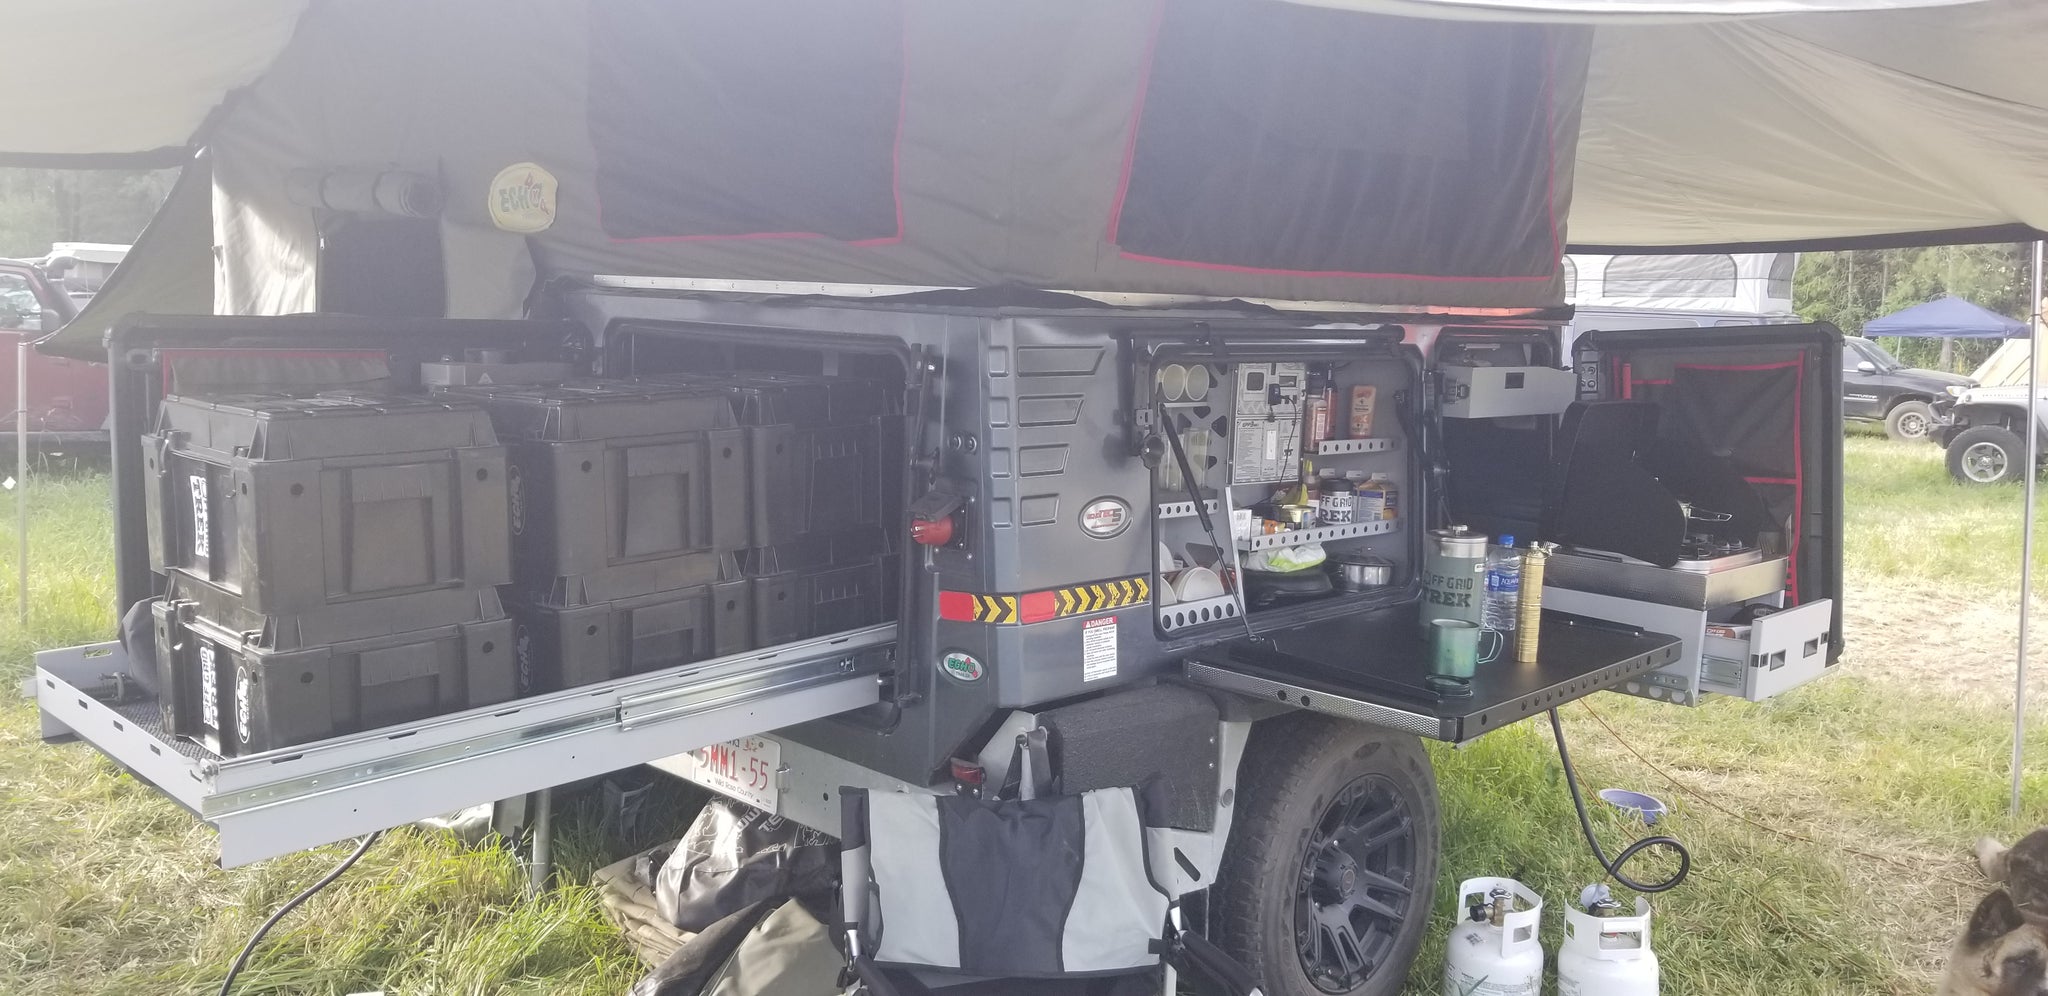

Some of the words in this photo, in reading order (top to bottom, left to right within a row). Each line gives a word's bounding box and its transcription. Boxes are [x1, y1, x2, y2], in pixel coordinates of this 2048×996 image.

[1320, 496, 1330, 506] FF
[192, 478, 205, 553] TREK
[1320, 508, 1351, 522] REK
[1447, 577, 1473, 590] GRID
[1091, 618, 1114, 628] DANGER
